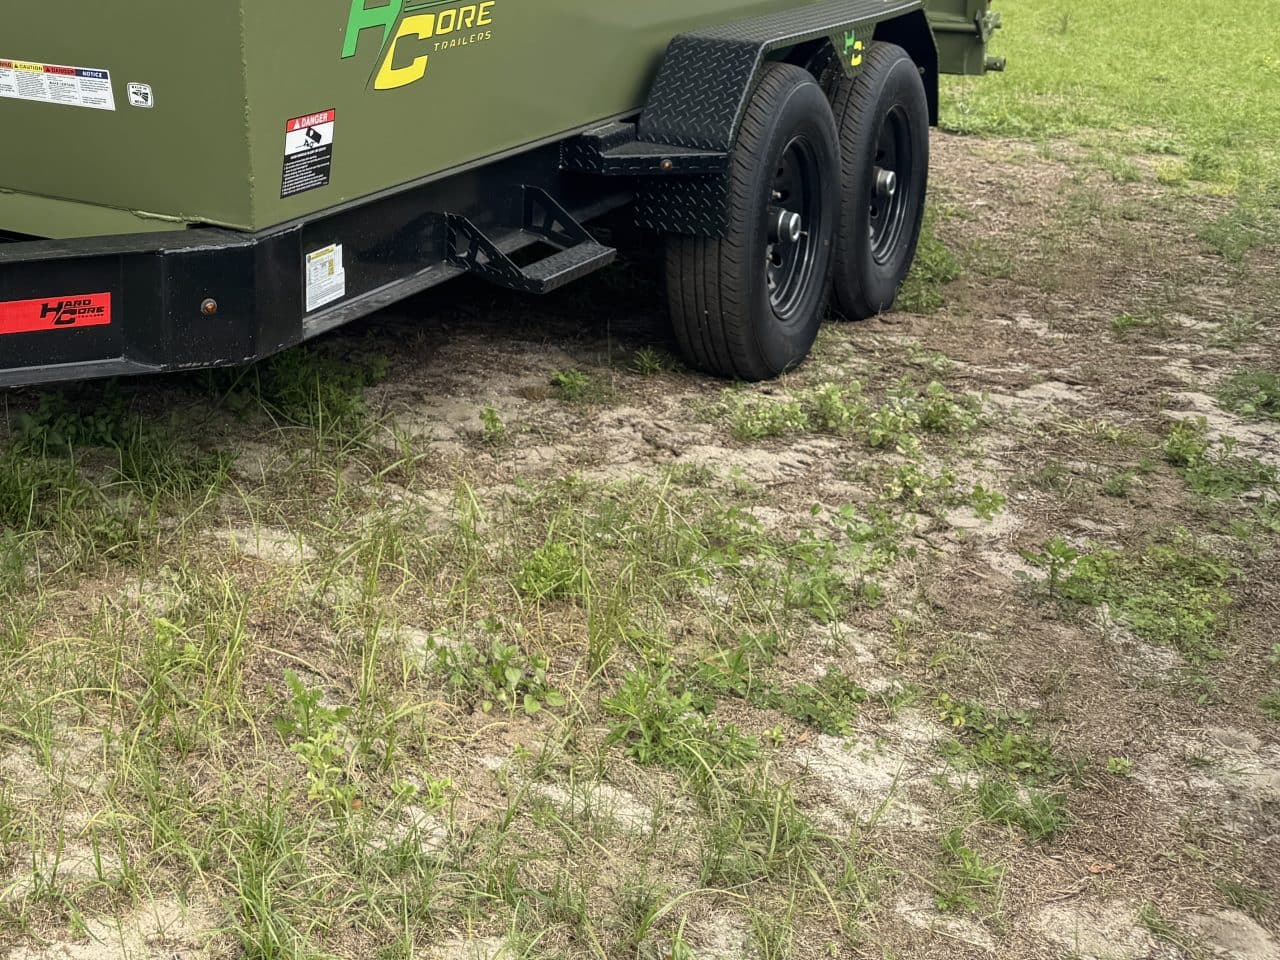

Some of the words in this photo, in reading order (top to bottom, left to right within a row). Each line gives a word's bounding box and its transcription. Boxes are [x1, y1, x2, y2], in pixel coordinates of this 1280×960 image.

[374, 0, 496, 91] CORE
[433, 31, 492, 52] TRAILERS
[302, 113, 328, 126] DANGER
[40, 299, 91, 318] HARD
[54, 306, 104, 325] CORE
